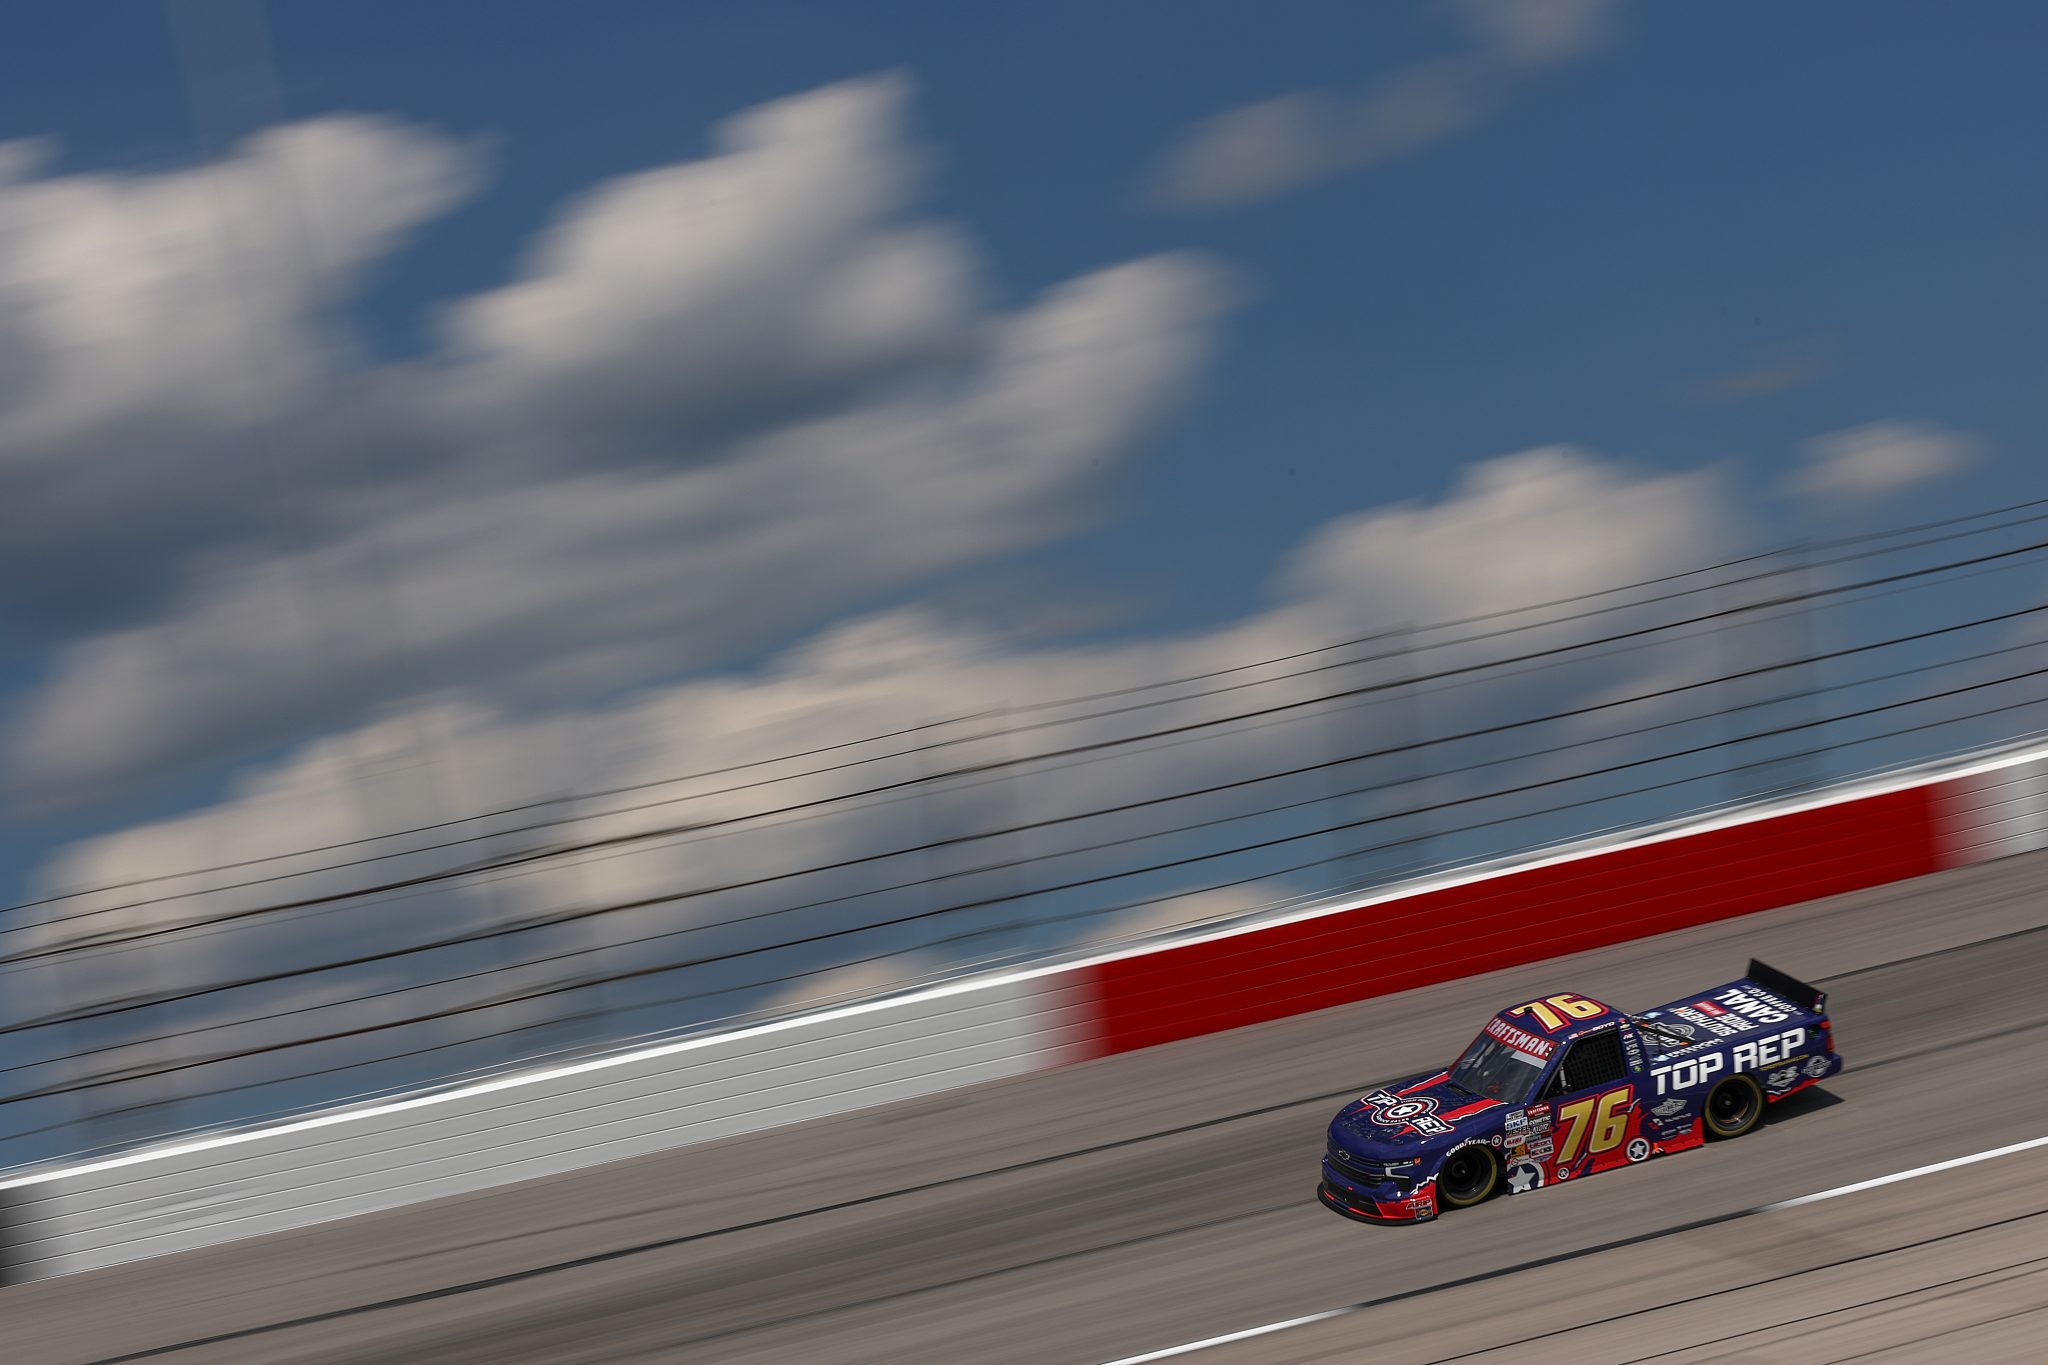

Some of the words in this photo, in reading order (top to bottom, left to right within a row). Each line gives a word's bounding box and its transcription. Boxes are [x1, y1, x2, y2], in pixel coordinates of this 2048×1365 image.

[1508, 993, 1604, 1031] 76
[1670, 1006, 1739, 1037] SOUTHERN
[1714, 988, 1789, 1023] CANAL
[1716, 1013, 1759, 1031] PRIDE
[1487, 1017, 1550, 1056] CRAFTSMAN
[1650, 1052, 1723, 1095] TOP
[1733, 1028, 1805, 1074] REP
[1506, 1118, 1527, 1130] SKF
[1555, 1087, 1631, 1165] 76
[1446, 1137, 1488, 1157] GOODYEAR
